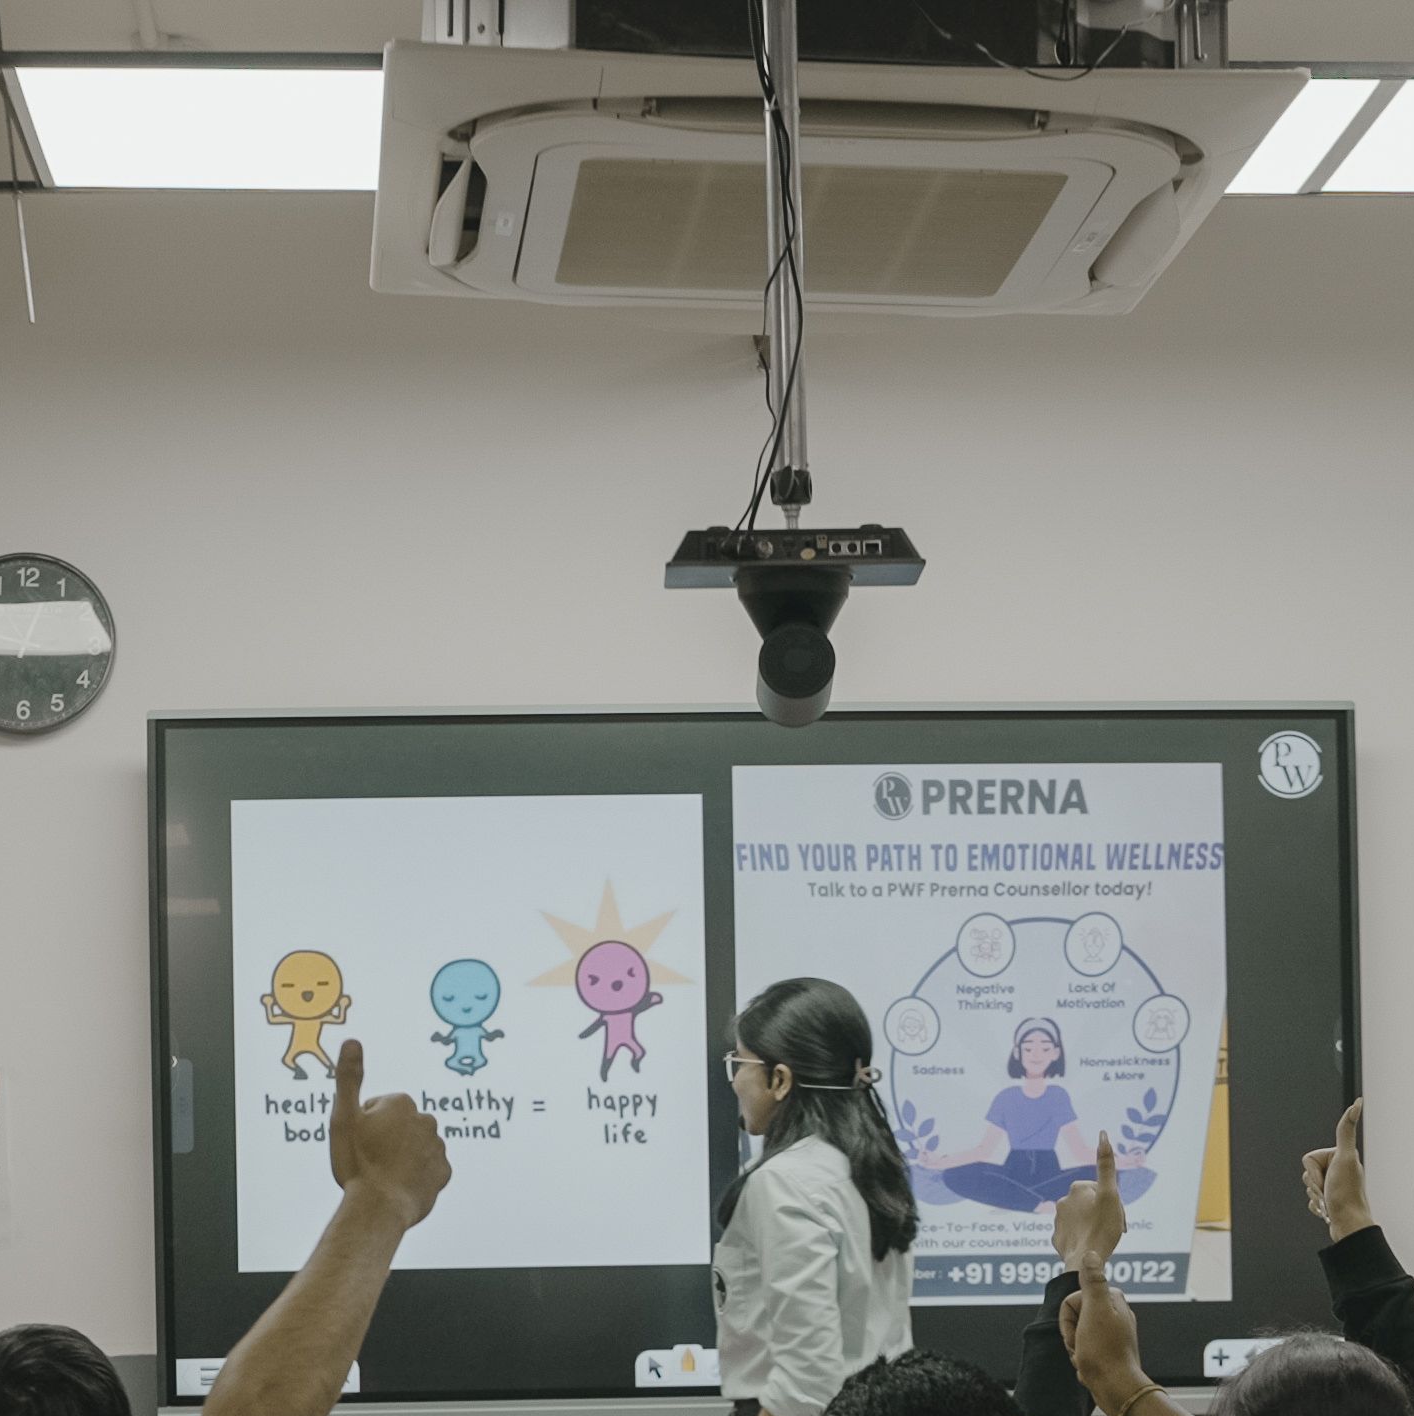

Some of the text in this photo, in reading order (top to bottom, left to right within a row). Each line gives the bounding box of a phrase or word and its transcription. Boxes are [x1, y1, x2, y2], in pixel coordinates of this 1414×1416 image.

[17, 567, 40, 587] 12
[57, 578, 65, 597] 1
[76, 669, 91, 689] 4
[16, 700, 31, 720] 6
[50, 694, 64, 712] 5
[922, 778, 1090, 815] PRERNA
[735, 841, 1224, 873] FIND YOUR PATH TO EMOTIONAL WELLNESS
[807, 881, 1153, 901] Talk to a PWF Prerna Counsellor today!
[955, 983, 1016, 997] Negative
[1068, 981, 1117, 994] Lack Of
[957, 999, 1014, 1013] Thinking
[1056, 998, 1125, 1010] Motivation
[911, 1063, 965, 1076] Sadness
[1079, 1055, 1171, 1067] Homesickness
[1115, 1070, 1145, 1081] More
[265, 1091, 336, 1115] healt
[422, 1089, 515, 1121] healthy
[586, 1088, 659, 1118] happy
[284, 1120, 326, 1143] bod
[444, 1118, 501, 1140] mind
[604, 1122, 648, 1145] life
[1011, 1220, 1053, 1232] Video
[941, 1239, 966, 1249] our
[968, 1236, 1050, 1249] counsellors
[948, 1262, 994, 1285] +91
